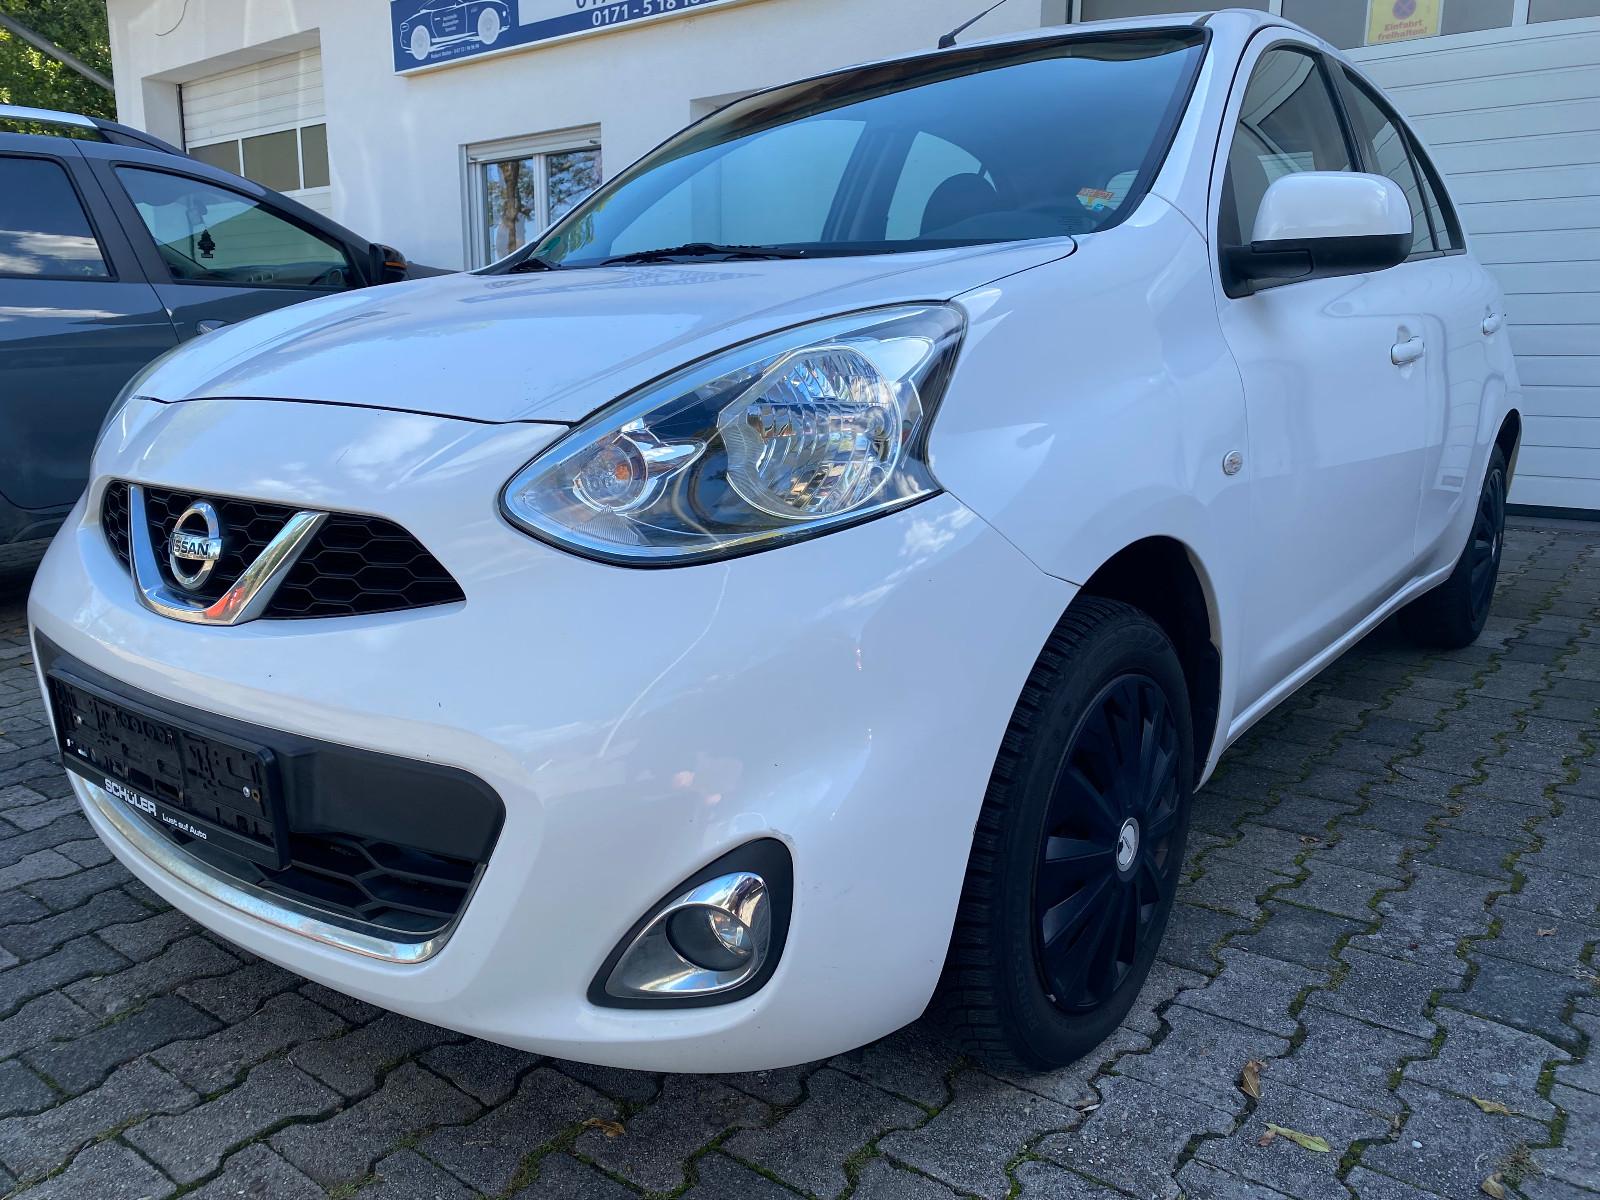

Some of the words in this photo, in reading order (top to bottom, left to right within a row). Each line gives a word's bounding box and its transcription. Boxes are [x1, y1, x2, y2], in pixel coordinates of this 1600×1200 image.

[592, 4, 628, 26] 0171
[1384, 19, 1423, 31] Einfahrt
[162, 813, 178, 827] Lust
[178, 822, 189, 831] auf
[190, 825, 207, 840] Auto
